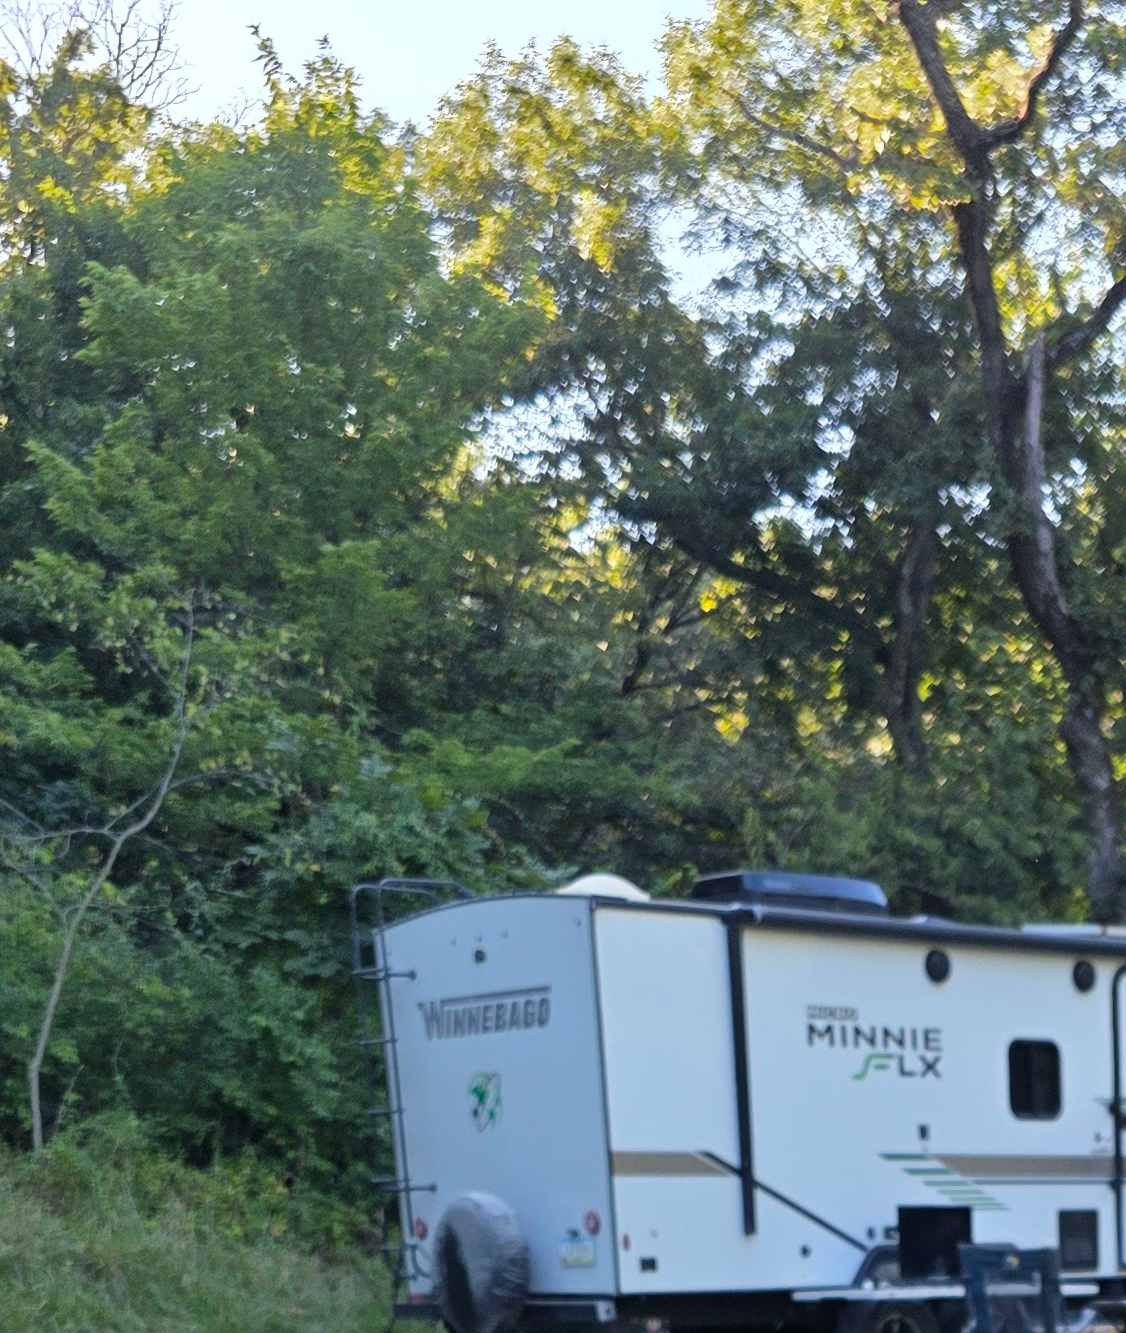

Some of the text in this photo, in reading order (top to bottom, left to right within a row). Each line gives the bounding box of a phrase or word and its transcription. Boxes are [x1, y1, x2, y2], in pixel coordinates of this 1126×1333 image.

[417, 995, 550, 1041] WINNEBAGO
[807, 1023, 943, 1051] MINNIE
[853, 1053, 943, 1080] FLX
